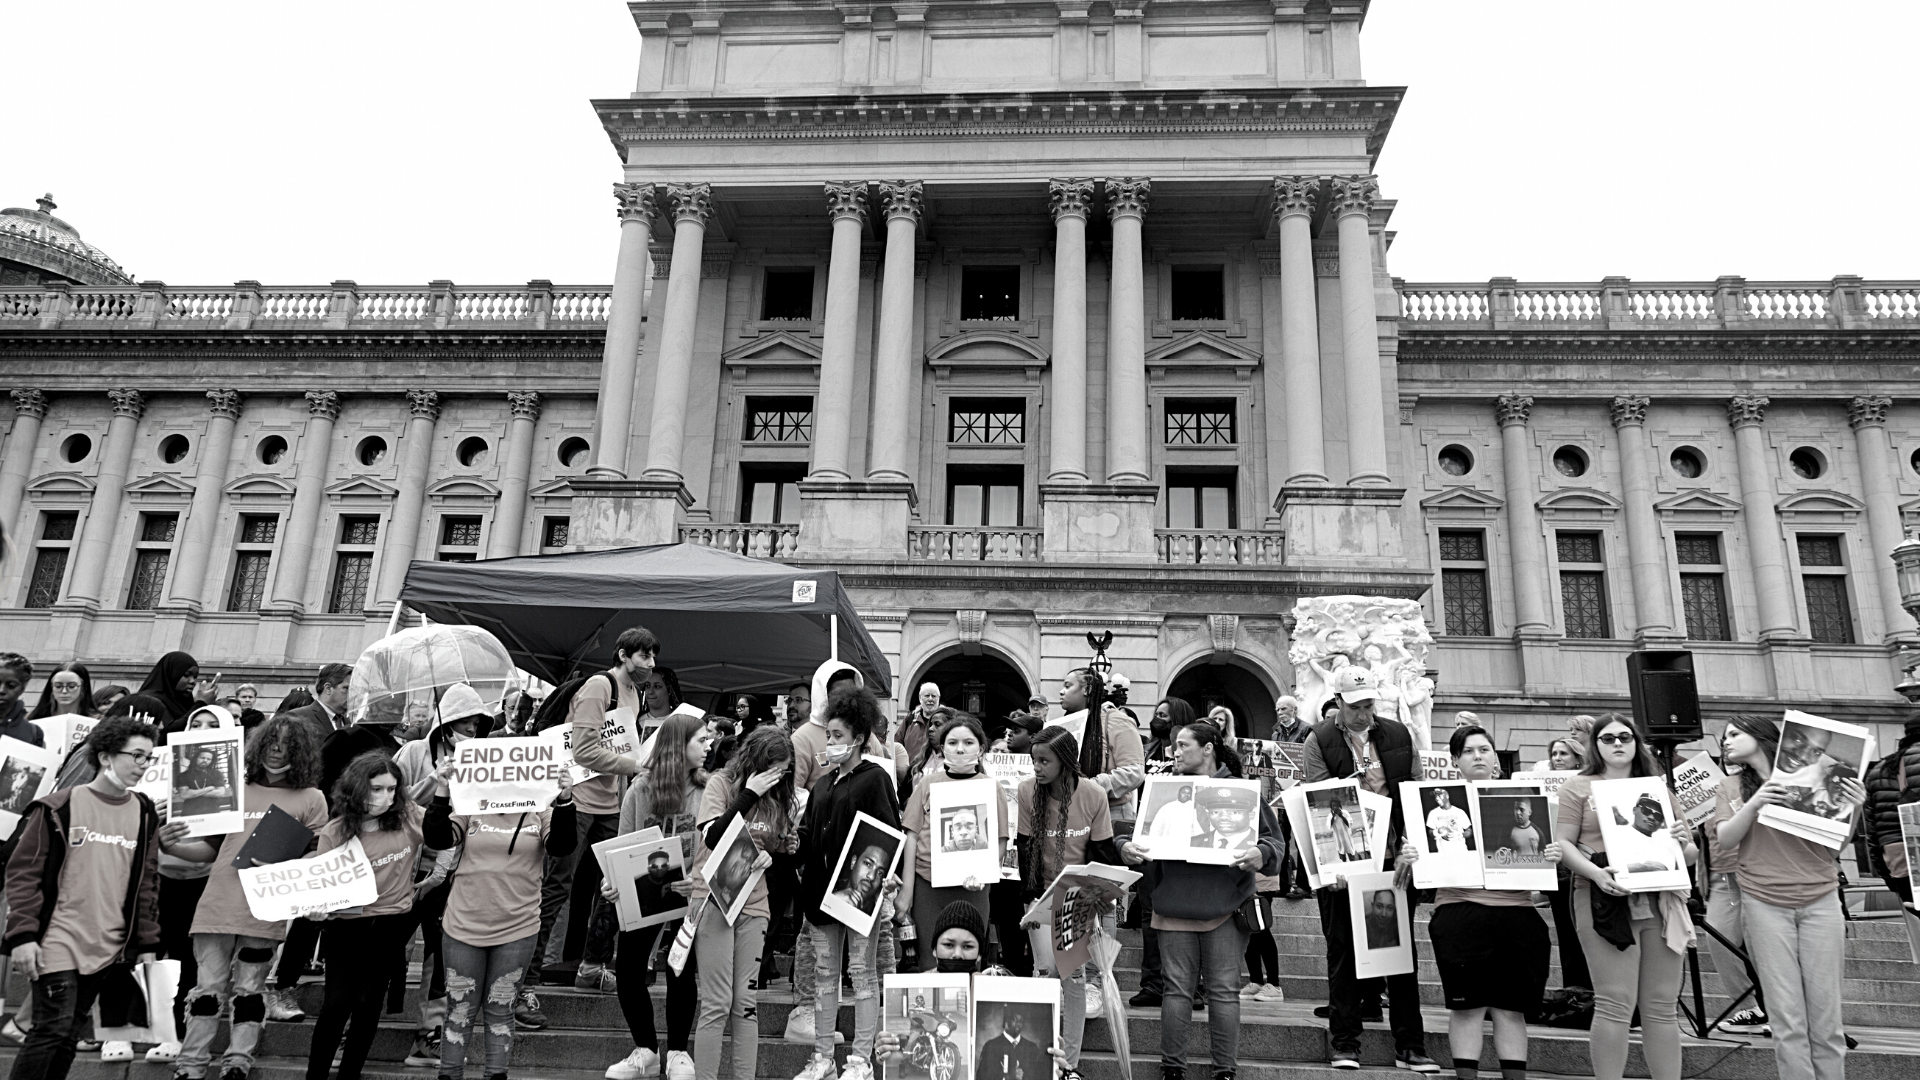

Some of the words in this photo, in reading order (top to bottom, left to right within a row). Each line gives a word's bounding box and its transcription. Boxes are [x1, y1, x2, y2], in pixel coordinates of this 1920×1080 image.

[461, 747, 504, 764] END
[509, 745, 553, 763] GUN
[990, 754, 1016, 765] JOHN
[1421, 756, 1448, 768] END
[454, 764, 559, 783] VIOLENCE
[1242, 765, 1276, 777] VOICES
[1278, 768, 1292, 779] OF
[1677, 766, 1698, 782] GUN
[1678, 783, 1704, 802] PORT
[254, 868, 303, 885] END
[308, 849, 356, 875] GUN
[252, 862, 368, 899] VIOLENCE
[1054, 908, 1063, 940] LIFE
[1062, 890, 1081, 947] FREE
